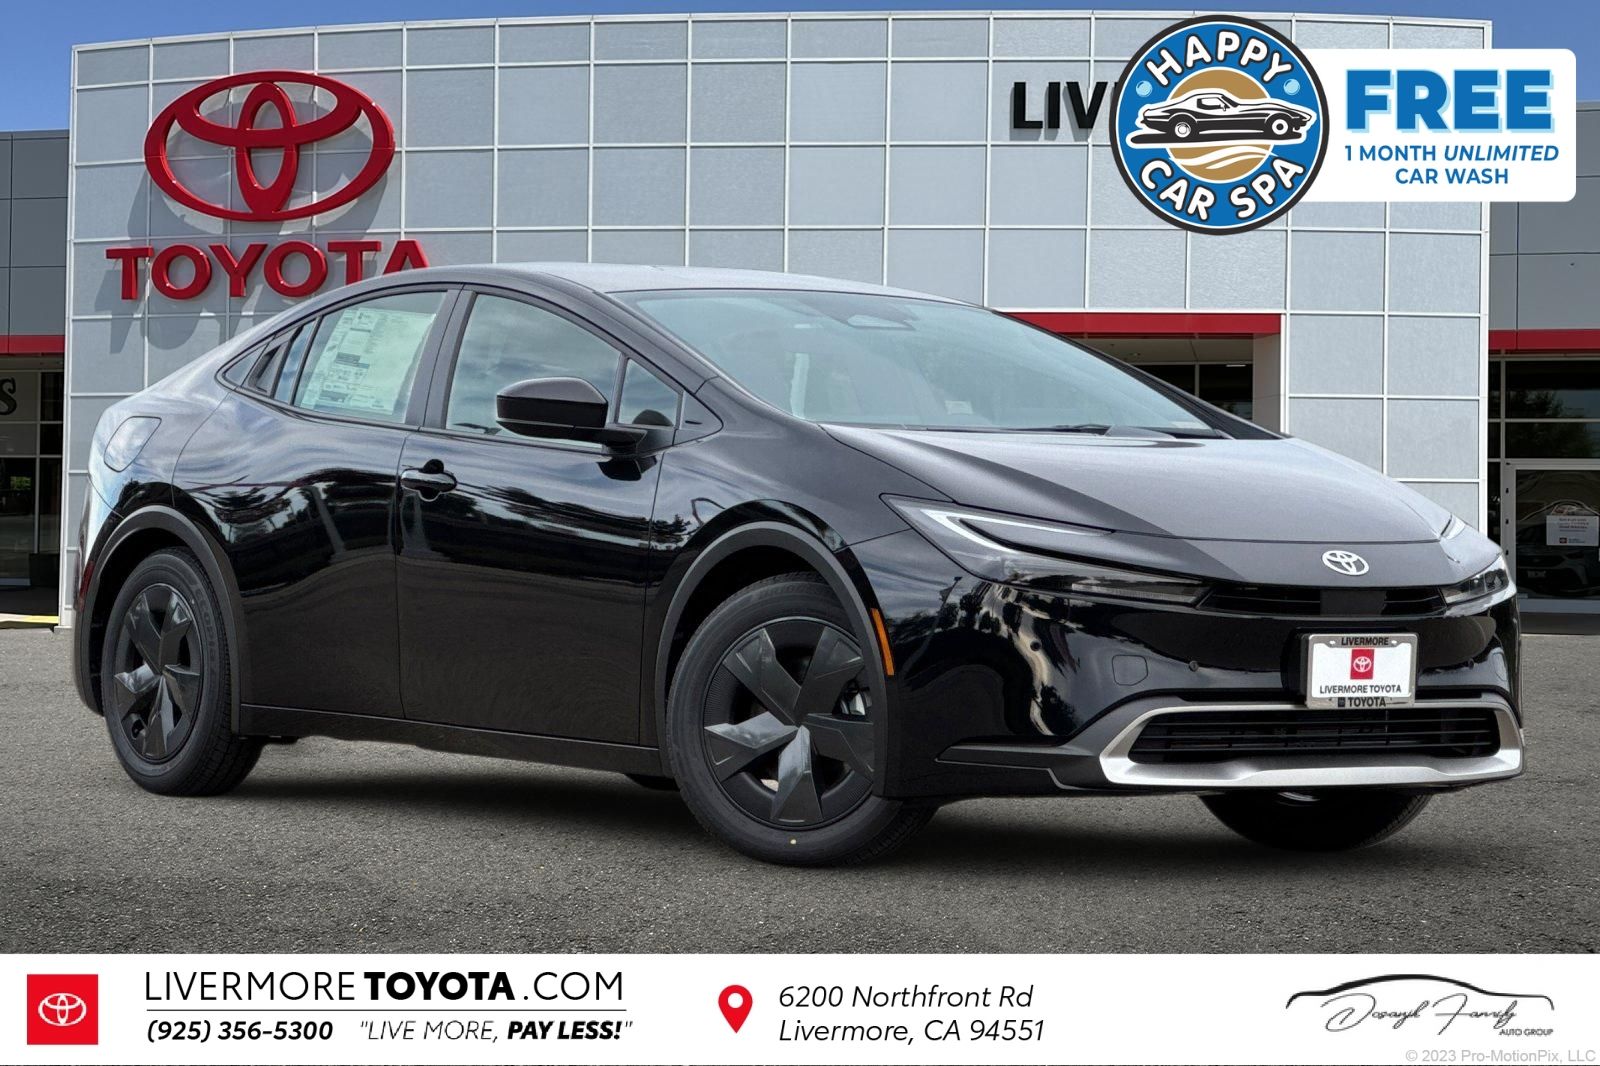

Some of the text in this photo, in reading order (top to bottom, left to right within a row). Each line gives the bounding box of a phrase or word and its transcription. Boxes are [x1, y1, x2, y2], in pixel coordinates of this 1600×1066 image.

[1012, 81, 1118, 129] LIV
[1341, 636, 1389, 646] LIVERMORE
[1319, 684, 1402, 695] LIVERMORE TOYOTA
[1348, 696, 1387, 708] TOYOTA
